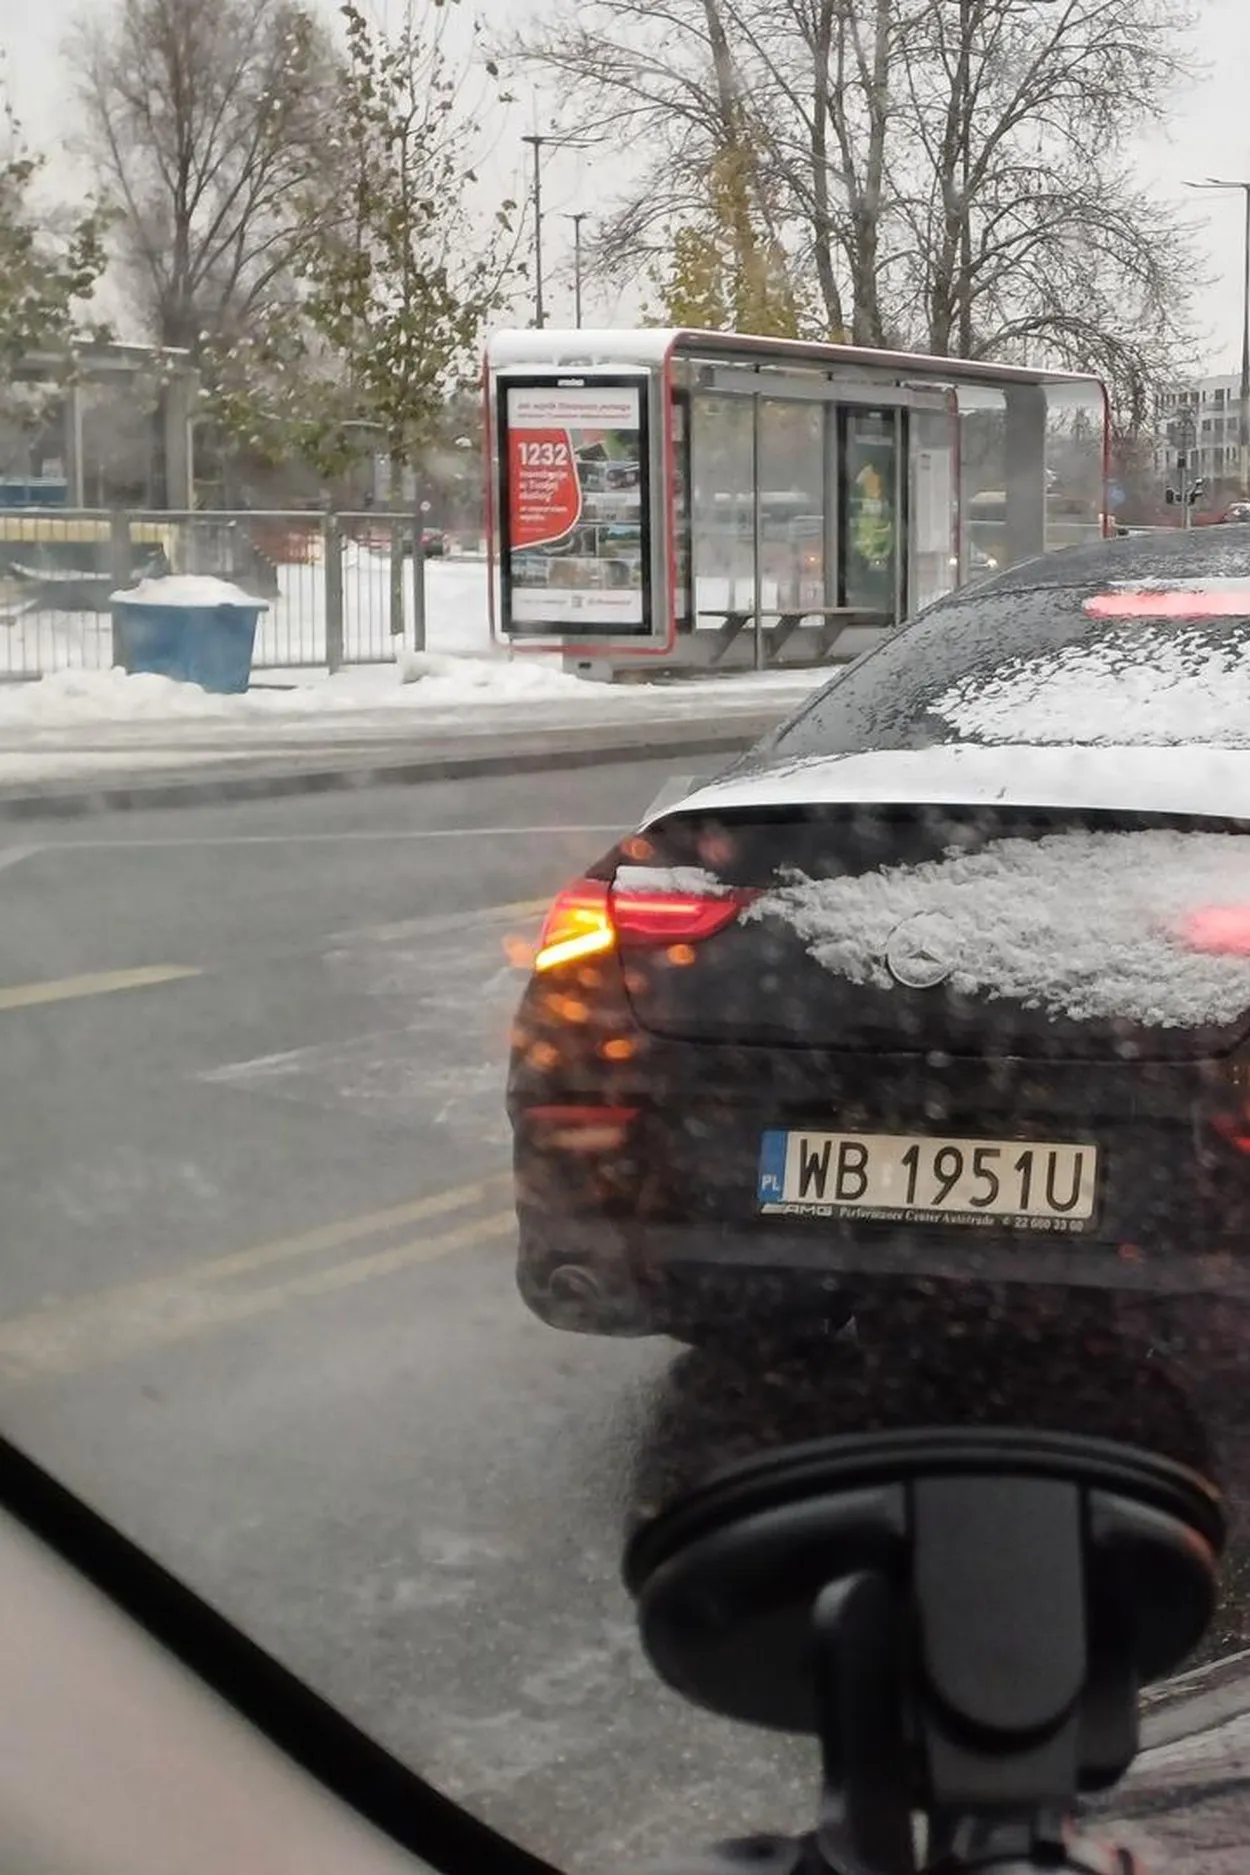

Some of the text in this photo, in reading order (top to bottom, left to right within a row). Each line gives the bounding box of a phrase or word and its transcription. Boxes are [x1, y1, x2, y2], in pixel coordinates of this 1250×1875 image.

[518, 442, 568, 466] 1232
[761, 1174, 781, 1191] PL
[799, 1138, 1084, 1213] WB 1951U
[784, 1204, 833, 1217] AMG
[839, 1206, 903, 1222] Performance
[904, 1209, 941, 1223] Center
